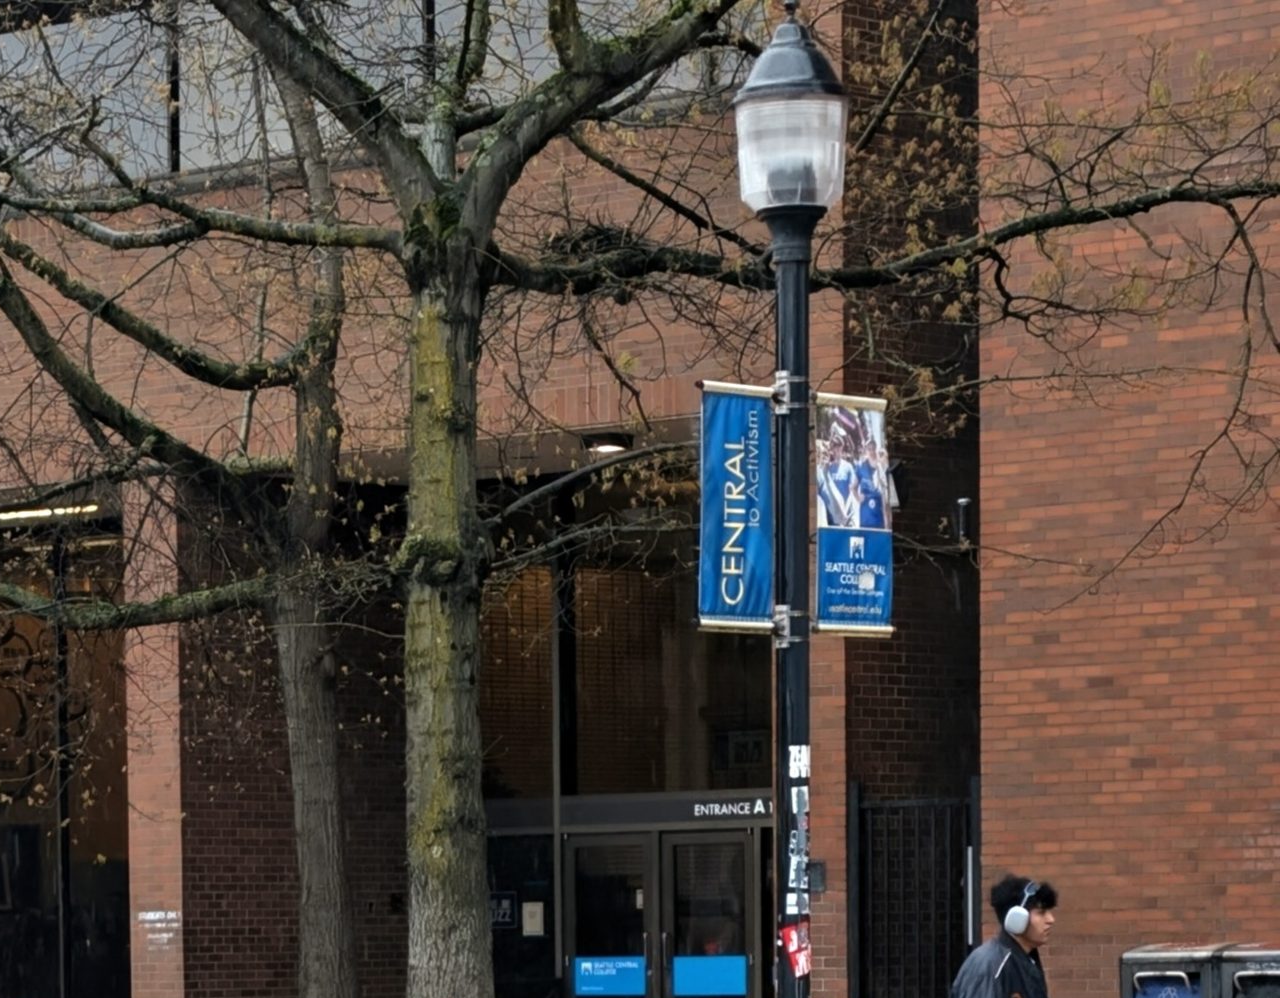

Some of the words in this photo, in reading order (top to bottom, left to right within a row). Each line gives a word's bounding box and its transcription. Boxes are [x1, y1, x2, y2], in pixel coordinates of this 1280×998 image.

[745, 409, 760, 501] Activism
[722, 437, 746, 606] CENTRAL
[825, 562, 854, 573] SEATTLE
[694, 802, 750, 816] ENTRANCE
[753, 798, 766, 814] A
